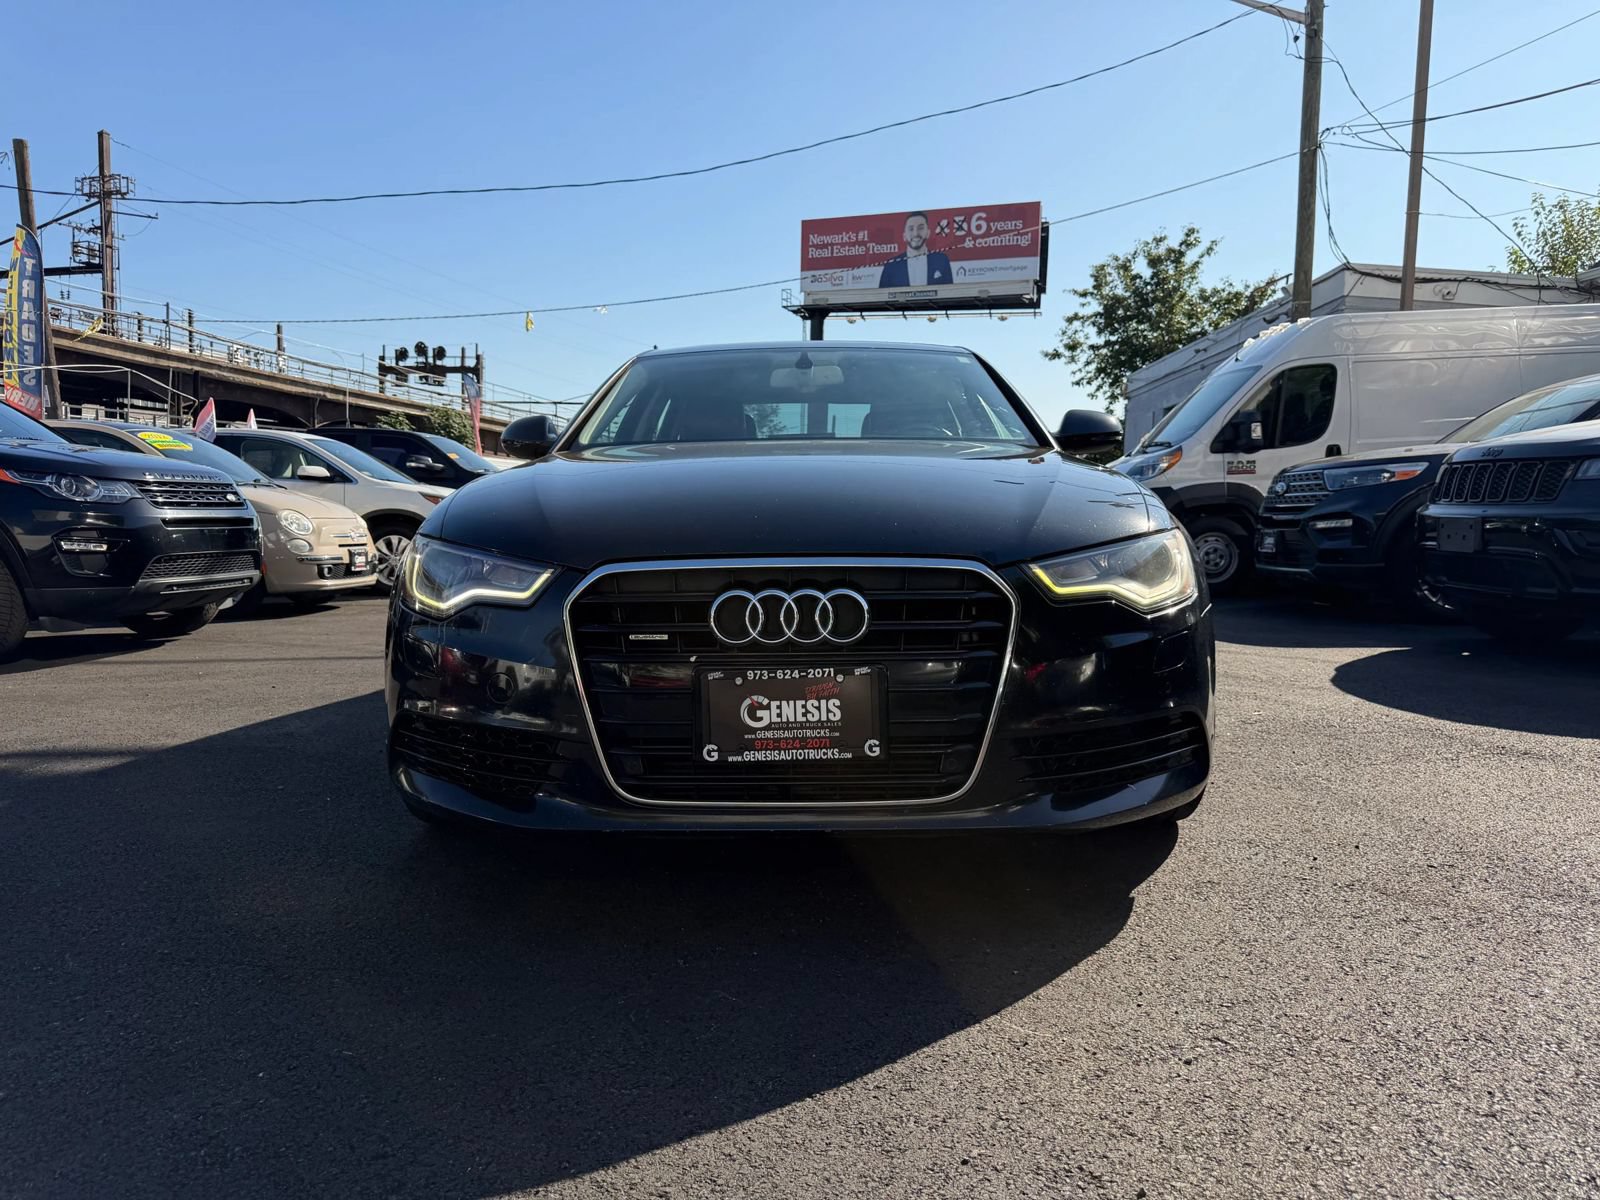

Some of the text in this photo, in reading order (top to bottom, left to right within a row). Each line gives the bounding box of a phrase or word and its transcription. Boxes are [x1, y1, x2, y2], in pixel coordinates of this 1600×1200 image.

[970, 212, 988, 235] 6
[990, 220, 1023, 233] years
[809, 230, 868, 245] Newark's #1
[976, 233, 1031, 247] counting!
[808, 243, 898, 258] Real Estate Team
[746, 668, 835, 680] 973-624-2071
[740, 695, 842, 728] GENESIS
[755, 738, 830, 749] 973-624-2071
